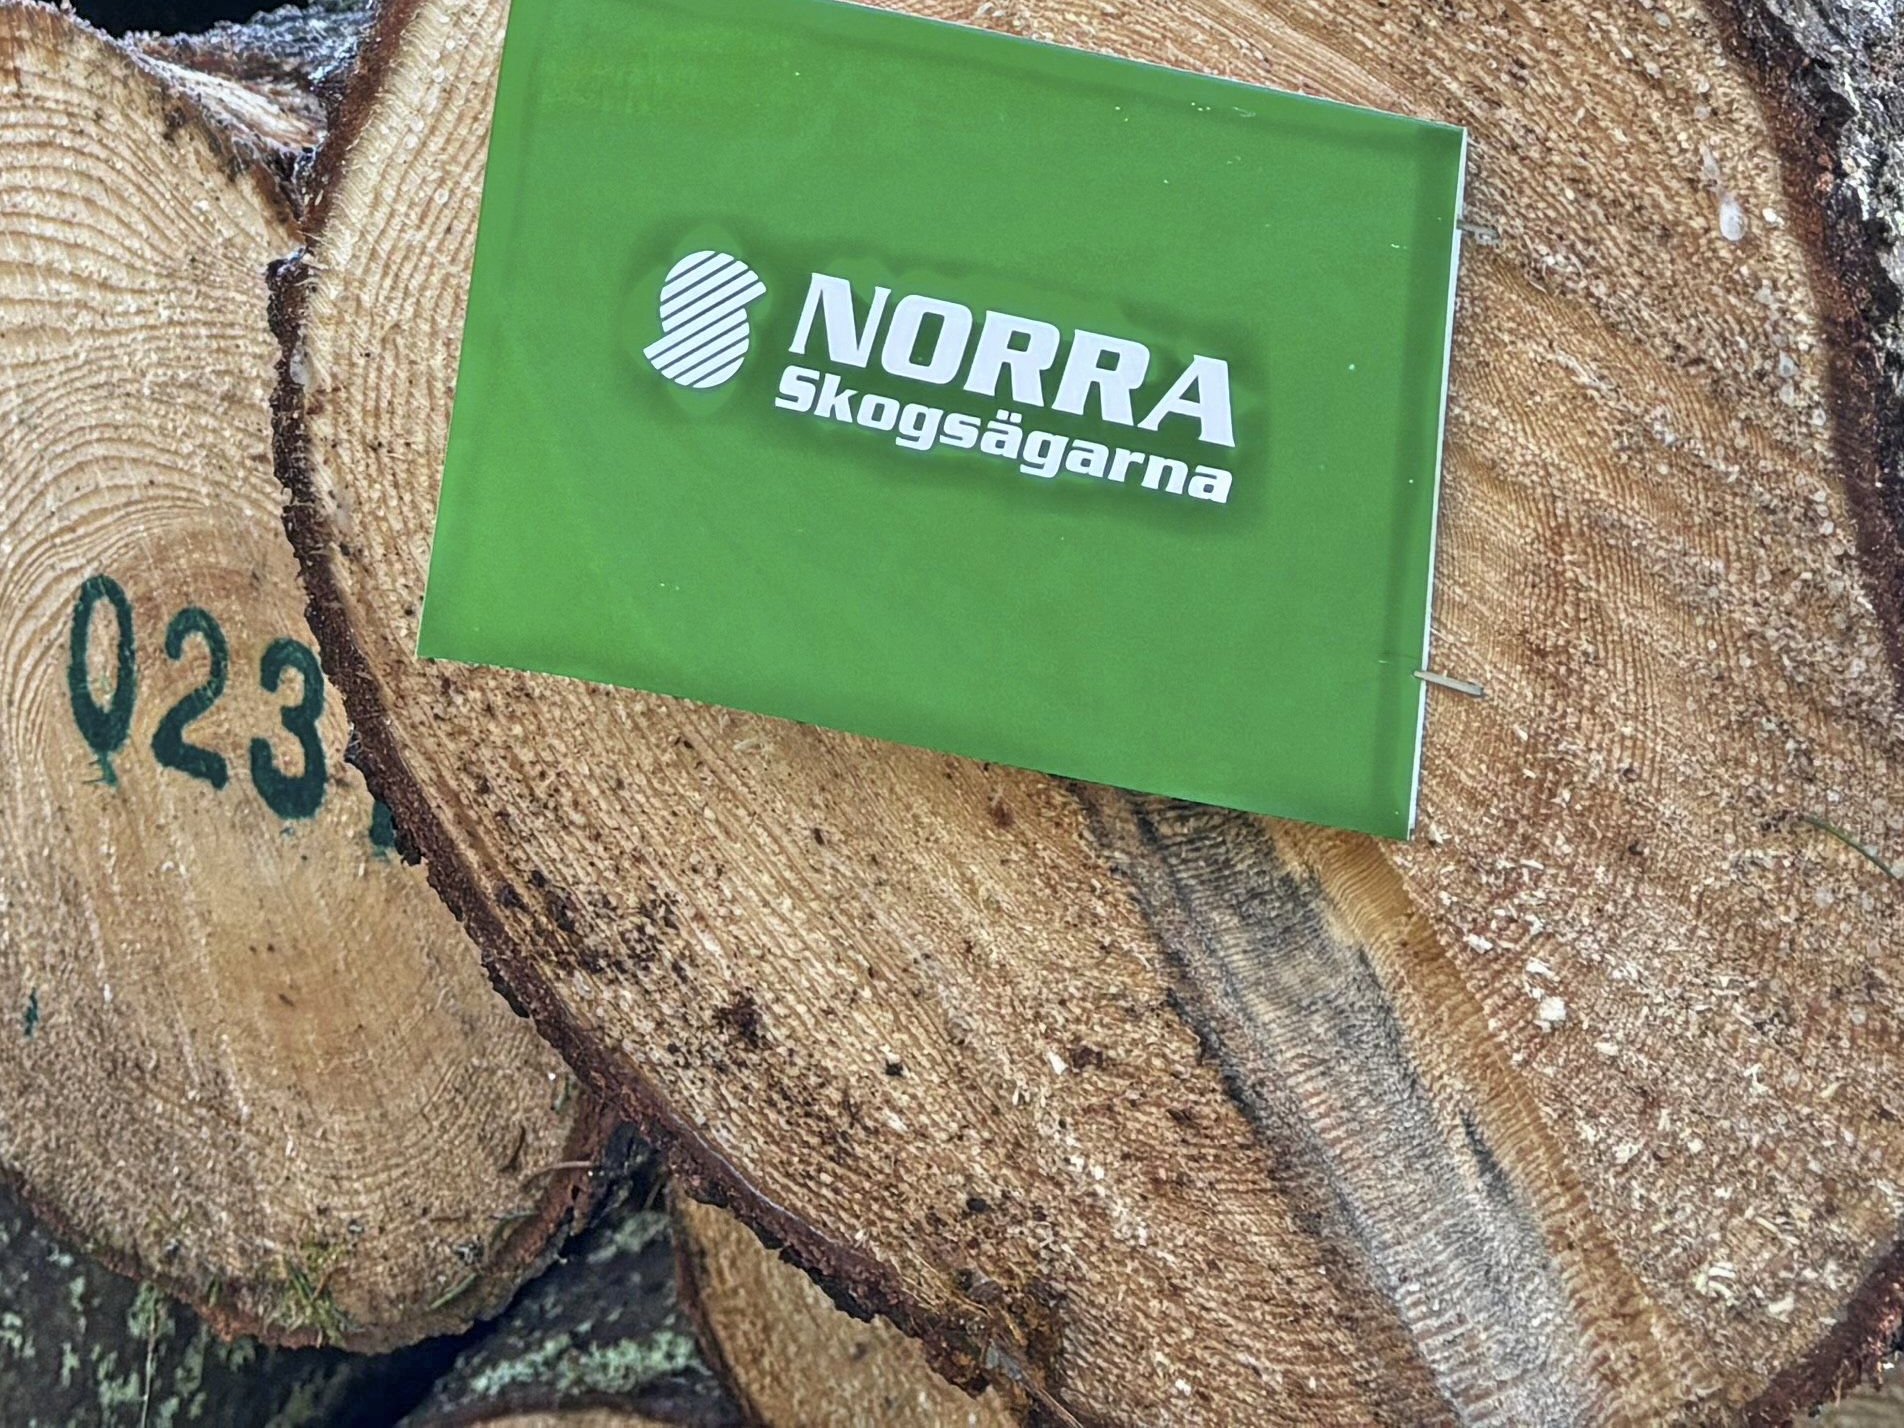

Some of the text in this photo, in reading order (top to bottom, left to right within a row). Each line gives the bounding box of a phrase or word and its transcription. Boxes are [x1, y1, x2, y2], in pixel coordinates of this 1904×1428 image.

[774, 364, 1234, 504] Skogsägarna
[788, 271, 1236, 448] NORRA
[67, 574, 398, 862] 023
